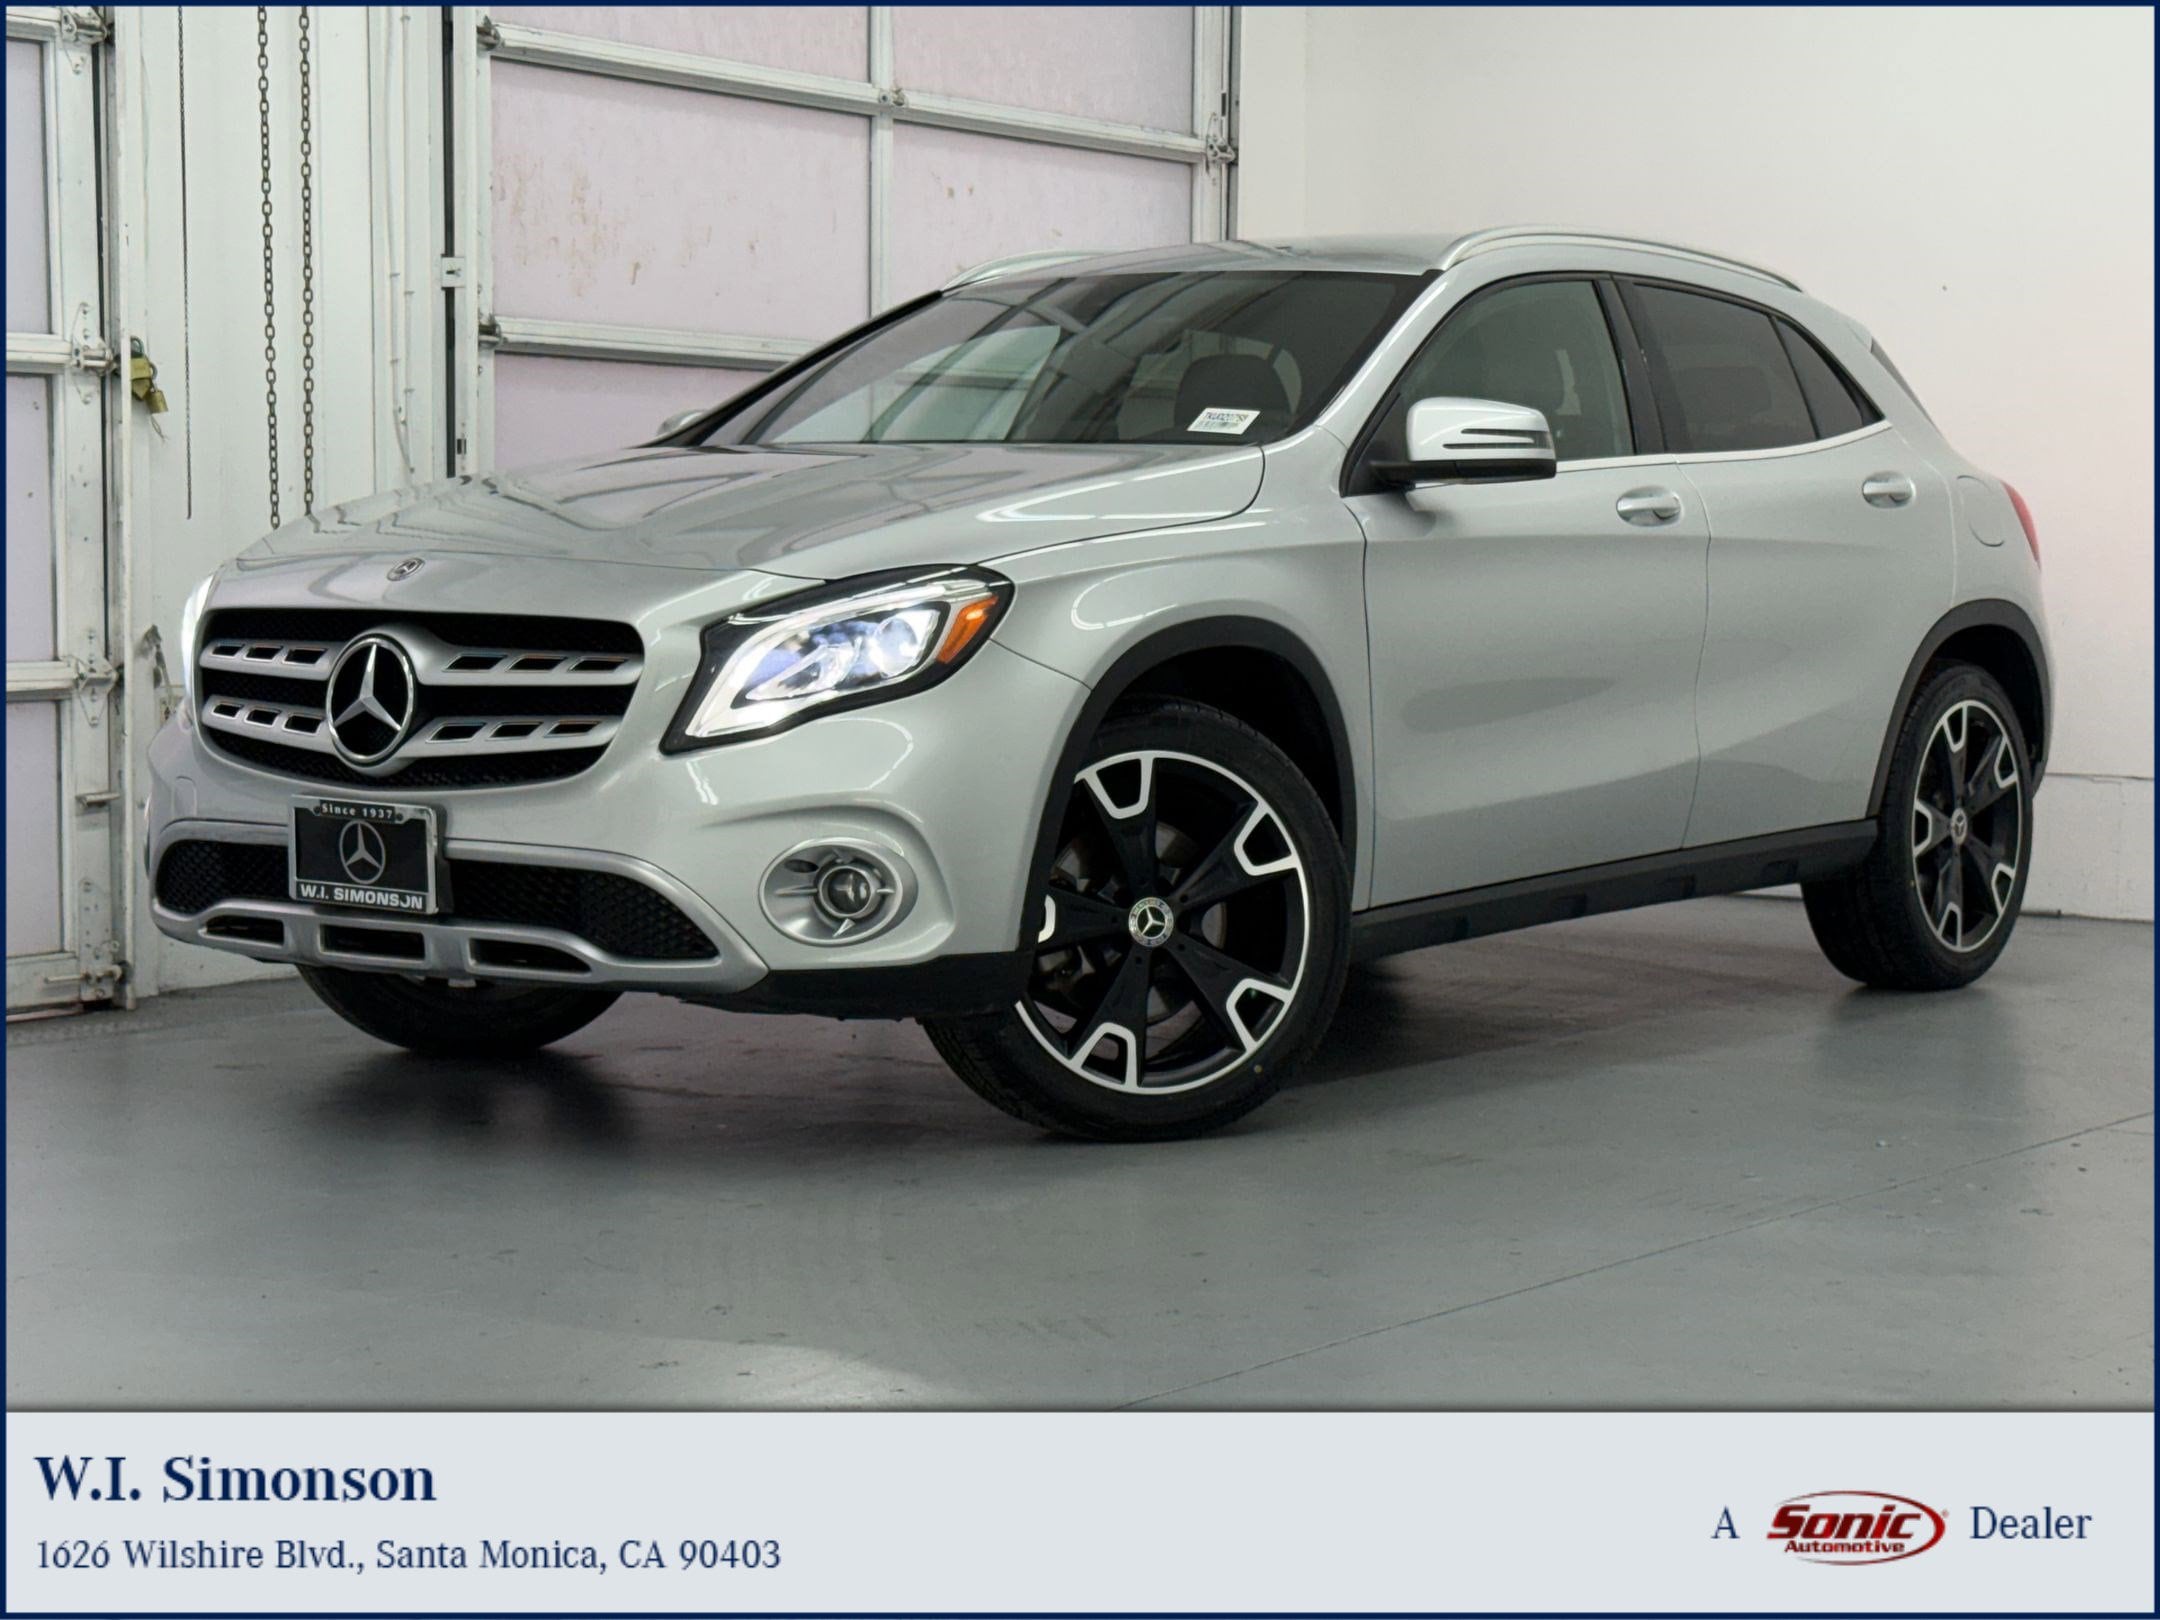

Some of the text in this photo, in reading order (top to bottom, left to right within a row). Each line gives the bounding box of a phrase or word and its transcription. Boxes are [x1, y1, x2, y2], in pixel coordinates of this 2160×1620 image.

[321, 803, 394, 819] Since 1937
[300, 884, 329, 899] W.I.
